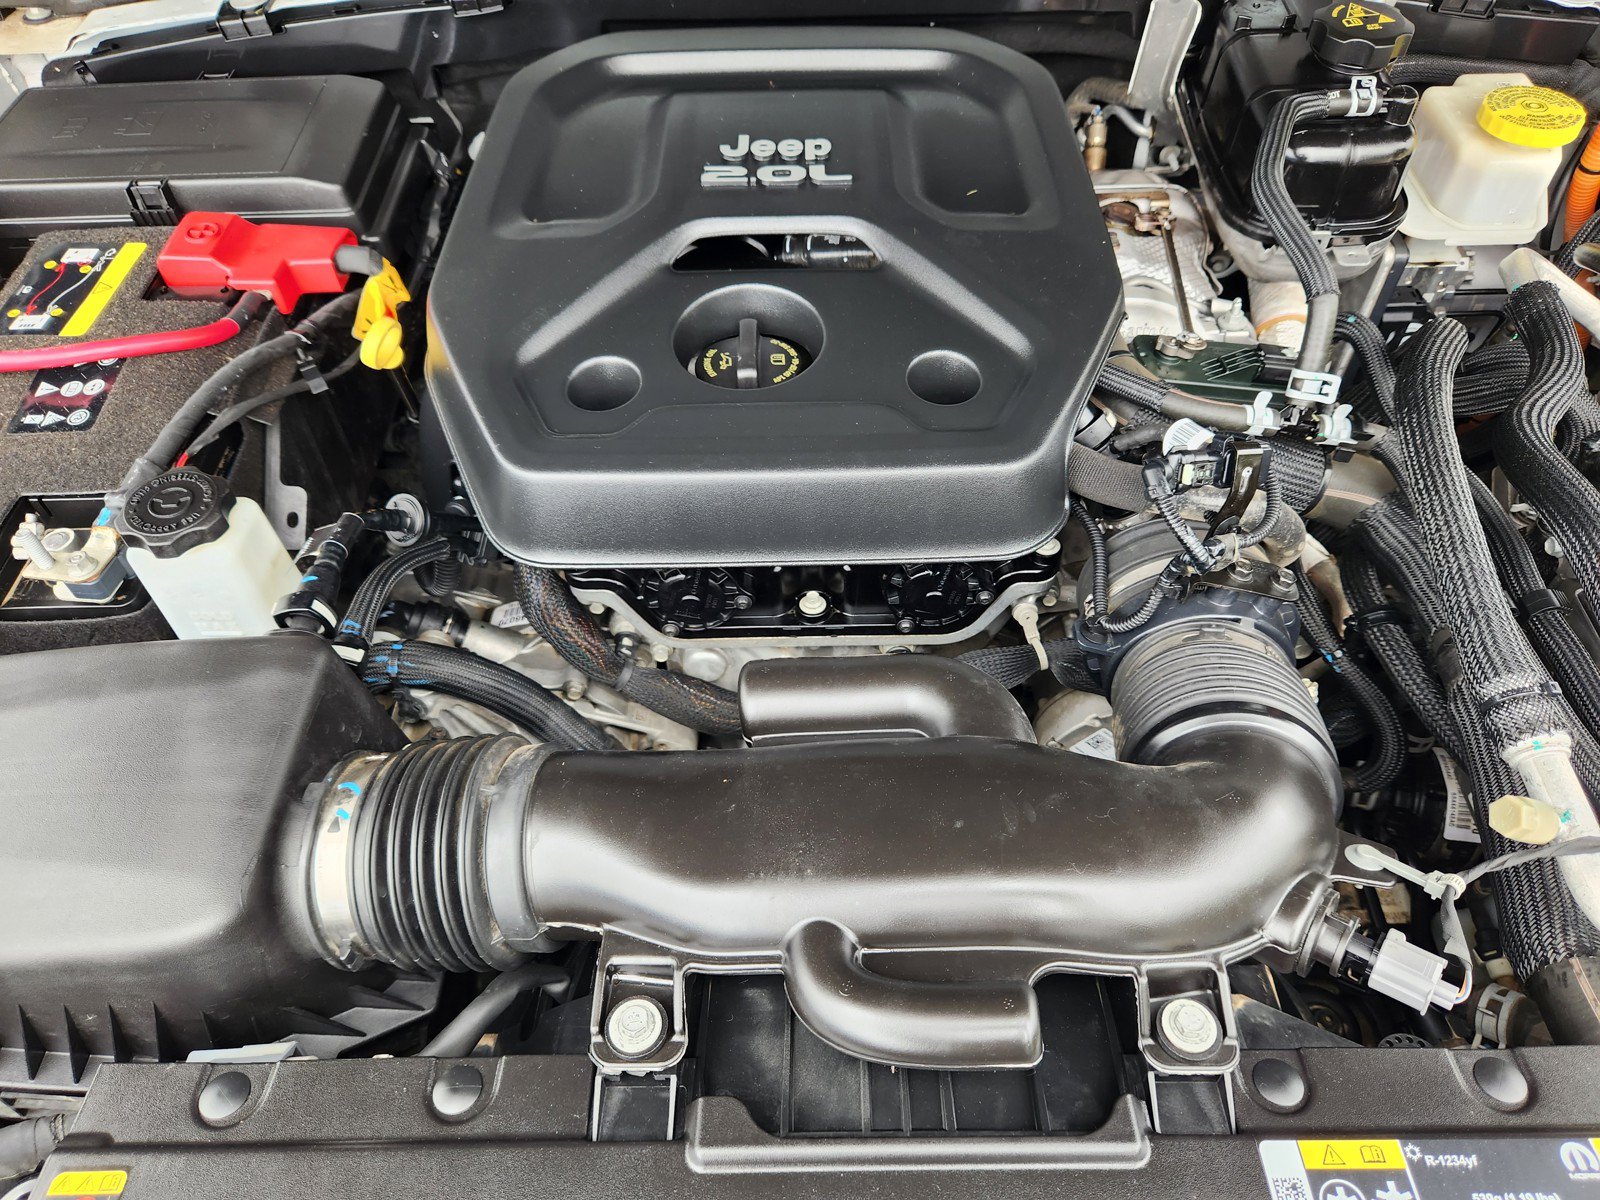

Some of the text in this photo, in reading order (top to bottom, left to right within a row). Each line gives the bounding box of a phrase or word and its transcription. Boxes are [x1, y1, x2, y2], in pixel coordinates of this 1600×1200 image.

[719, 134, 832, 163] Jeep
[700, 164, 853, 186] 2.0L
[1424, 1154, 1478, 1169] R-1234yf
